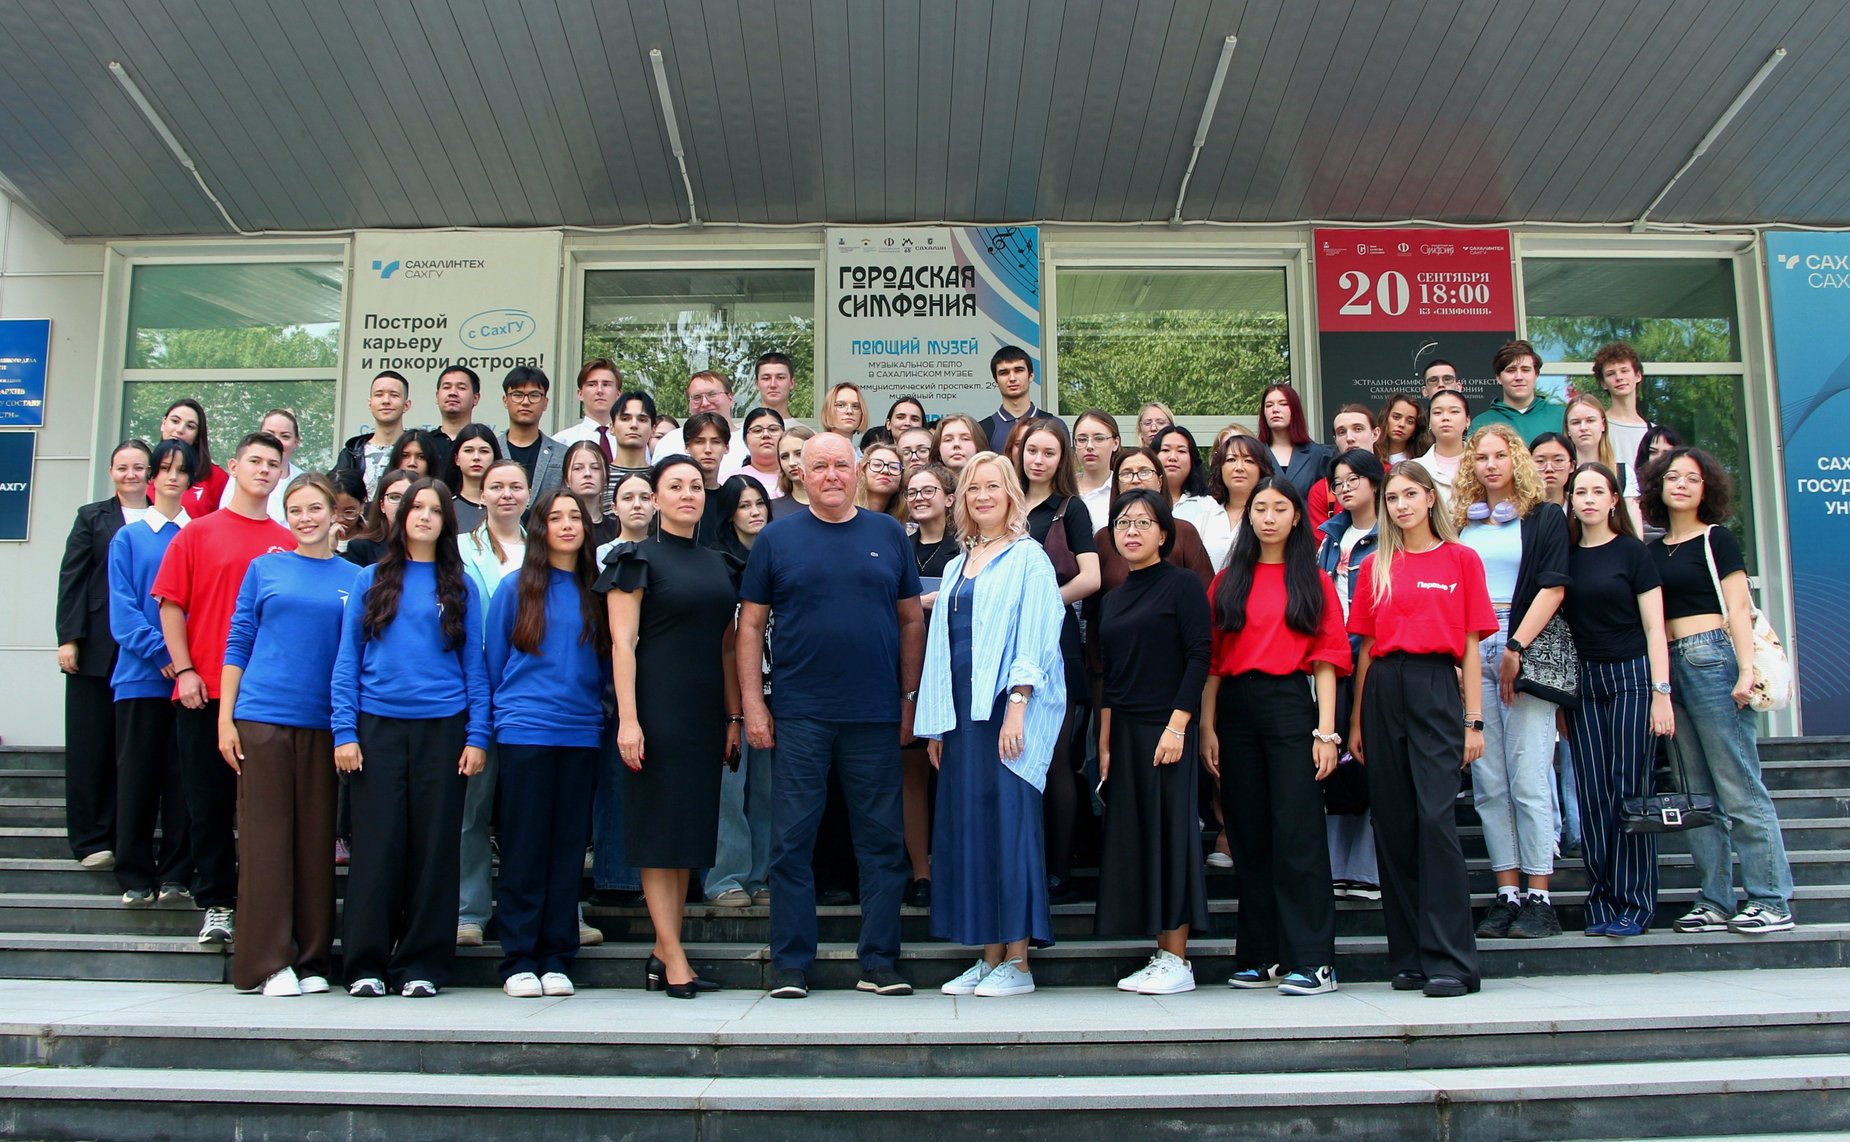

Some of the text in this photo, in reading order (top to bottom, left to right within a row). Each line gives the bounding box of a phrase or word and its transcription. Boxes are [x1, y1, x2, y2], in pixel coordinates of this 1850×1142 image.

[405, 260, 485, 269] САХАЛИНТЕХ
[405, 269, 444, 279] САХГУ
[839, 265, 975, 290] ГОРОДСКАЯ
[1416, 272, 1490, 283] СЕНТЯБРЯ
[1338, 270, 1410, 316] 20
[1419, 283, 1490, 304] 18:00
[838, 292, 976, 318] СИМФОНИЯ
[1419, 307, 1431, 315] КЗ
[364, 313, 448, 333] Построй
[468, 321, 525, 339] с СахГУ
[363, 337, 443, 353] карьеру
[851, 337, 979, 355] ПОЮЩИЙ МУЗЕЙ
[361, 353, 545, 373] и покори острова!
[876, 370, 942, 378] САХАЛИНСКОМ
[856, 383, 936, 392] оммунистический
[1370, 386, 1422, 394] САХАЛИНСКО
[936, 393, 957, 401] парк
[1824, 501, 1850, 515] УН
